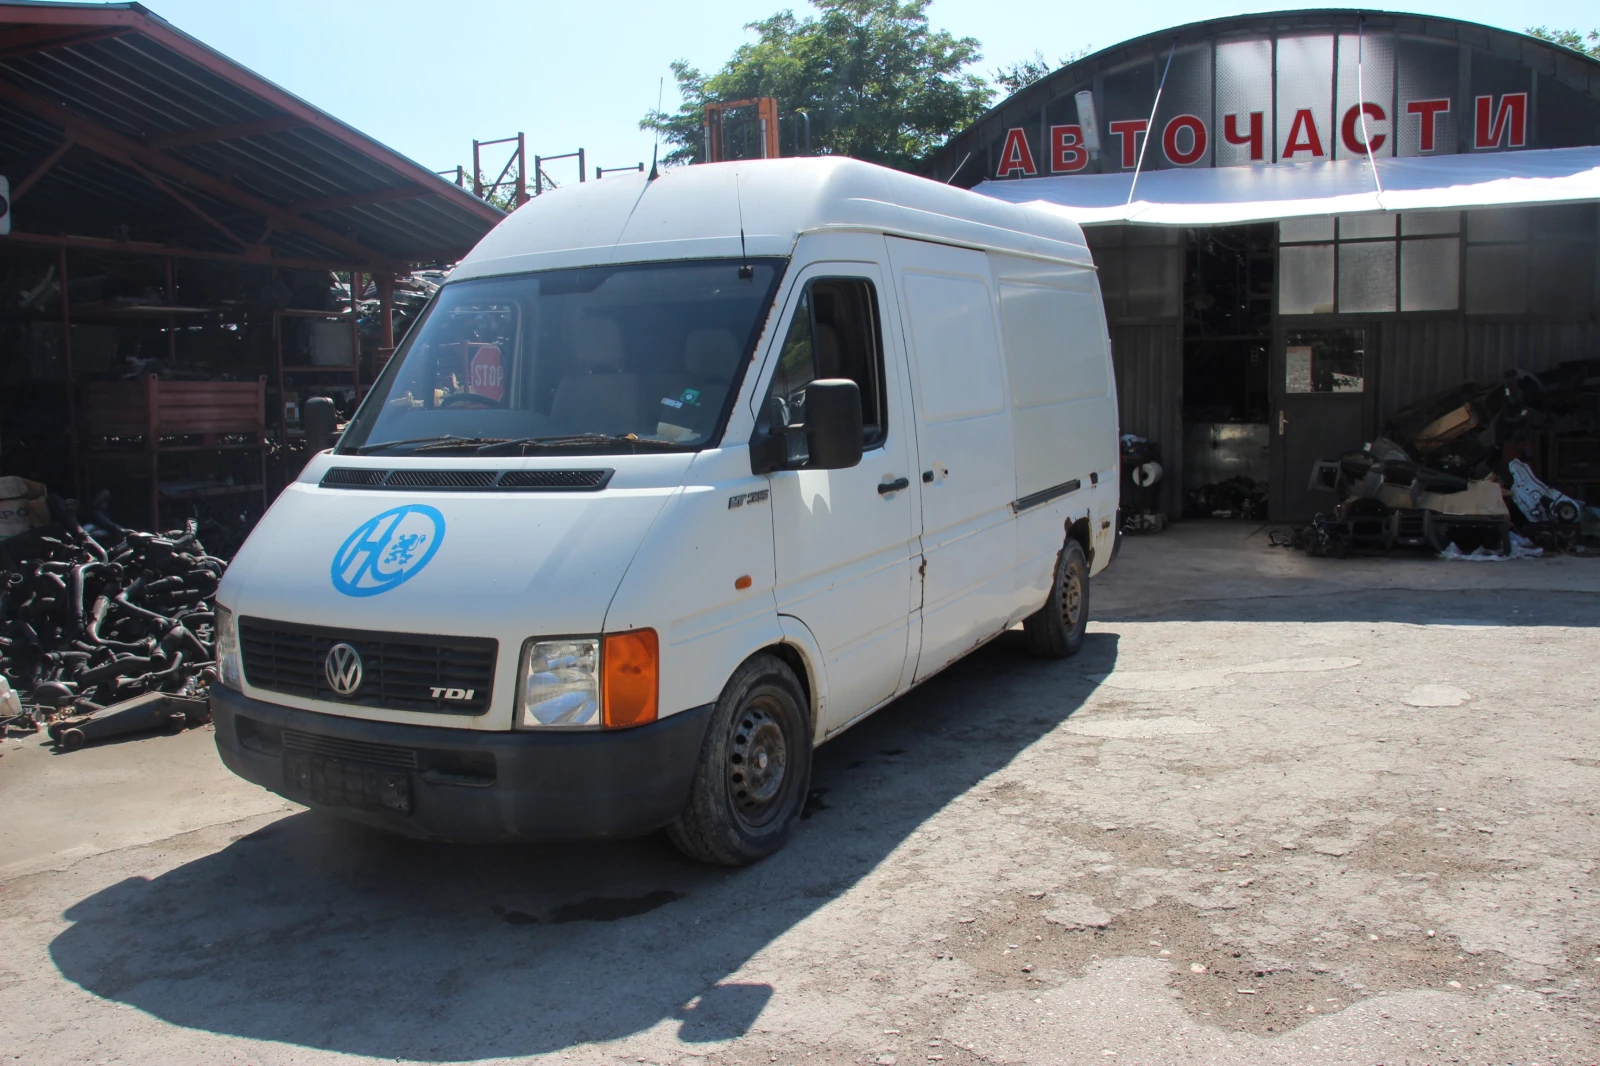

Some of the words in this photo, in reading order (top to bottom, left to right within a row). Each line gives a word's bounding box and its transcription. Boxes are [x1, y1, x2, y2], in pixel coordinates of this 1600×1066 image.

[996, 92, 1528, 177] АВТОЧАСТИ
[475, 364, 504, 387] STOP
[0, 508, 29, 520] PO
[429, 686, 475, 701] TDI
